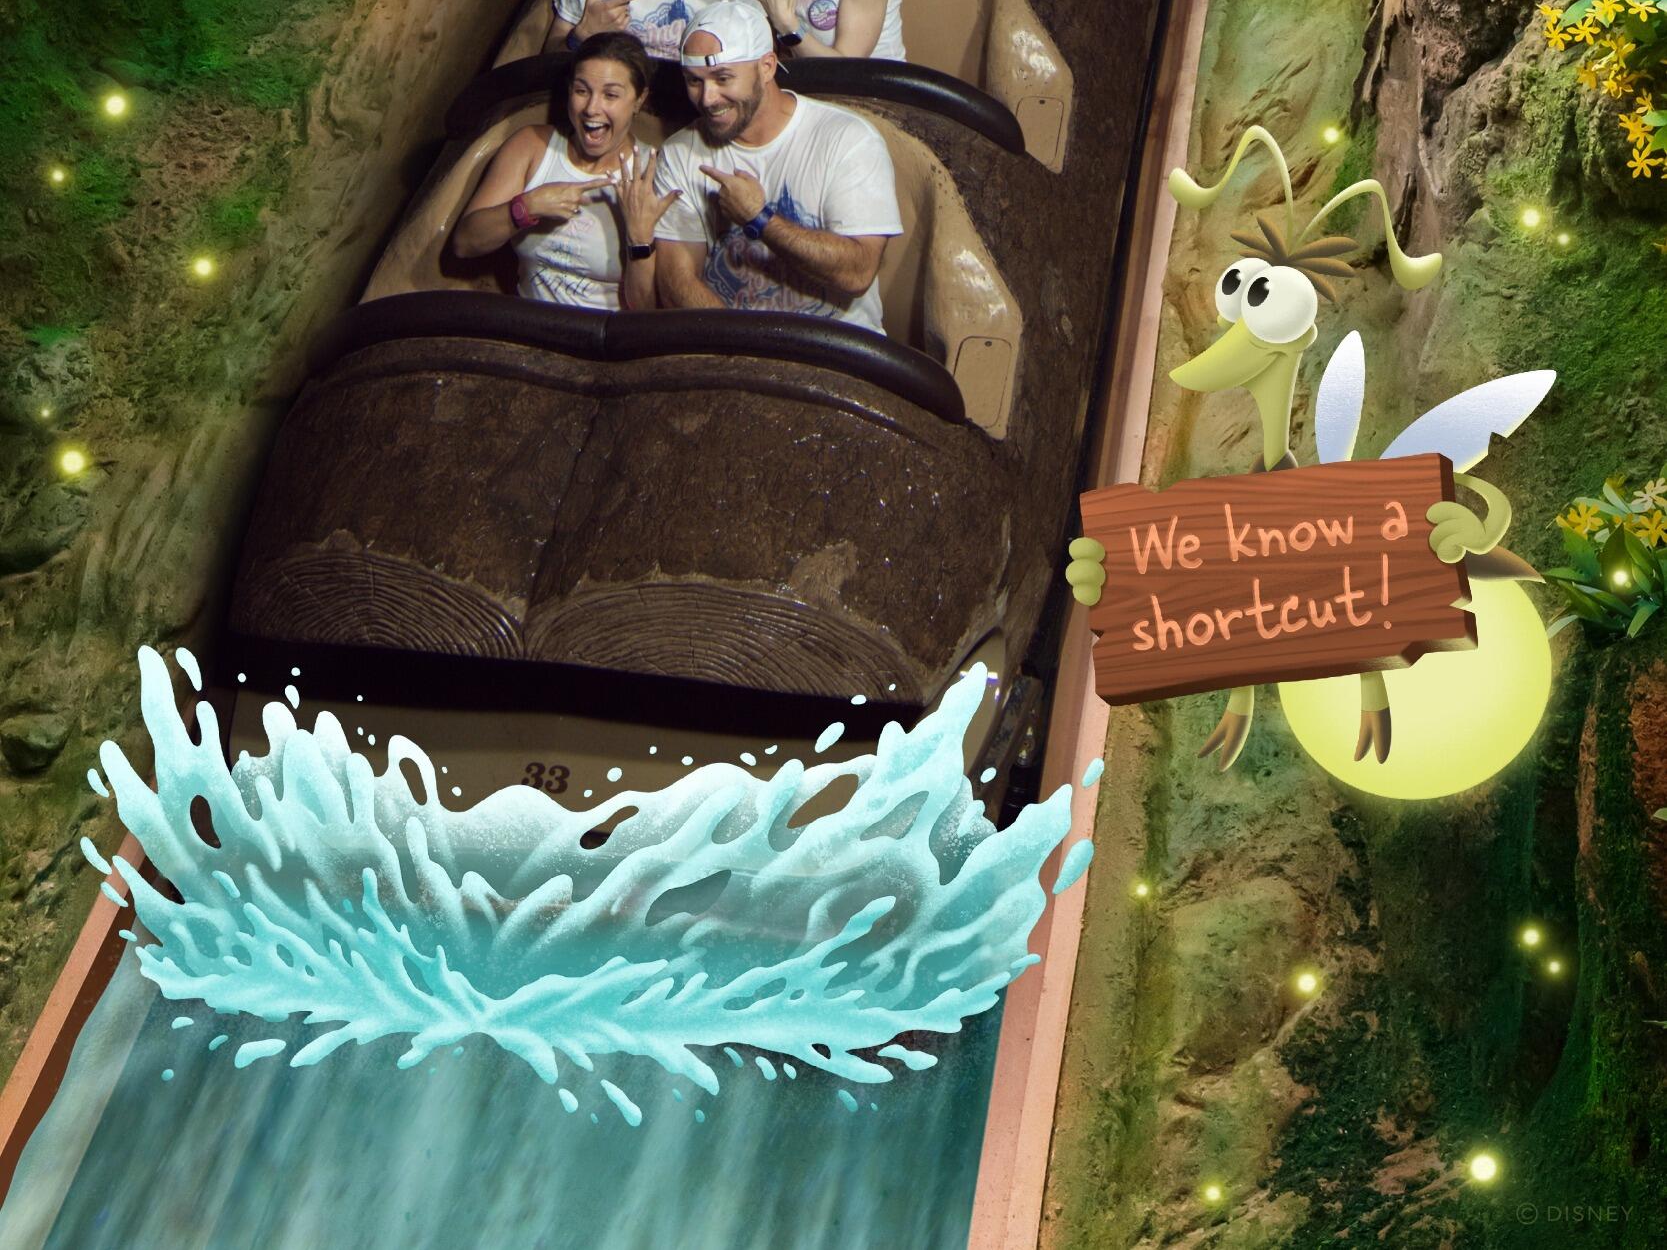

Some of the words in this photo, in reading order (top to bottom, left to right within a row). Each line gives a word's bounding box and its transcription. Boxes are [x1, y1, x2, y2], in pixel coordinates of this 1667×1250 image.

[1129, 515, 1204, 575] We
[1223, 502, 1354, 562] know
[1380, 501, 1410, 541] a
[1132, 553, 1394, 652] shortcut!
[521, 762, 570, 794] 33
